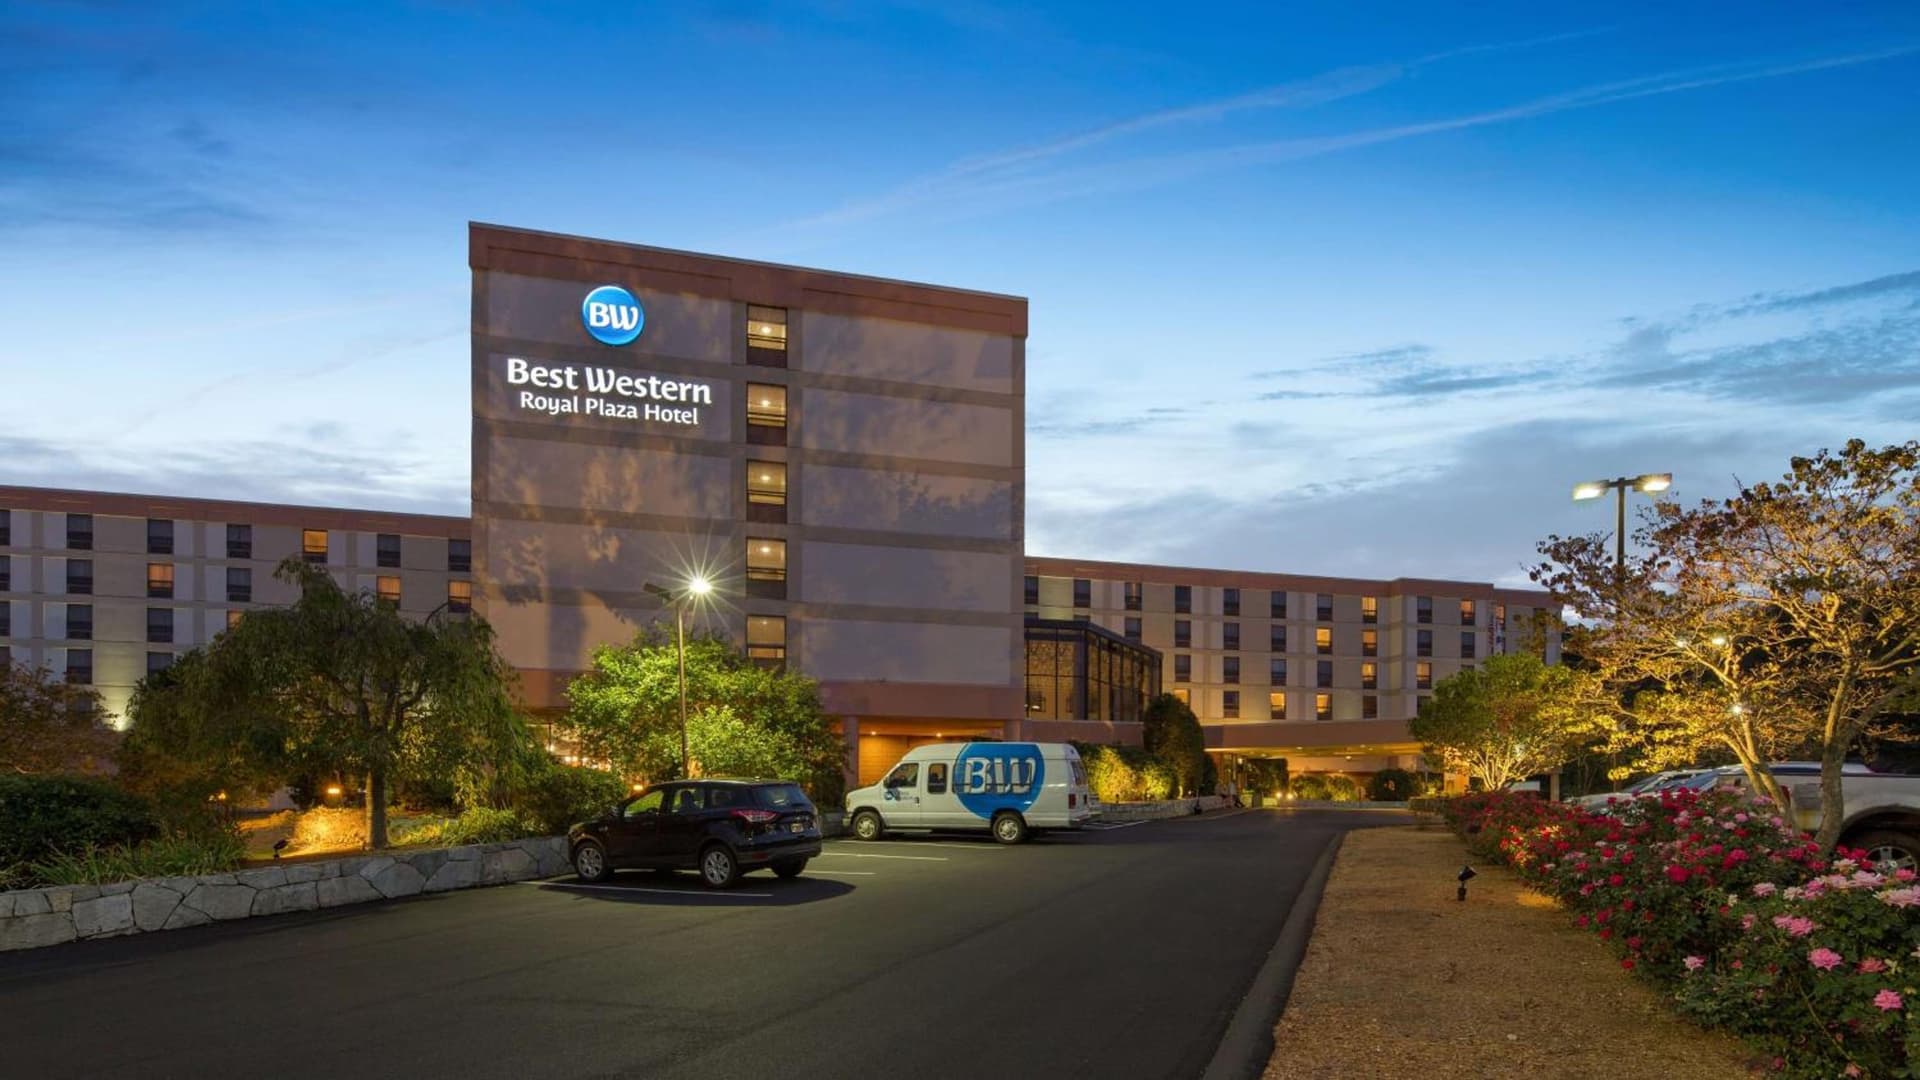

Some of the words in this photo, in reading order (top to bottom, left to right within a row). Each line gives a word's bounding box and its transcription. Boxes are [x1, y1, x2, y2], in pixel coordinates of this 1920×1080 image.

[589, 302, 638, 331] BW
[507, 358, 578, 390] Best
[585, 366, 712, 405] Western
[520, 391, 579, 416] Royal
[585, 398, 638, 419] Plaza
[645, 404, 699, 425] Hotel
[963, 757, 1036, 794] BW
